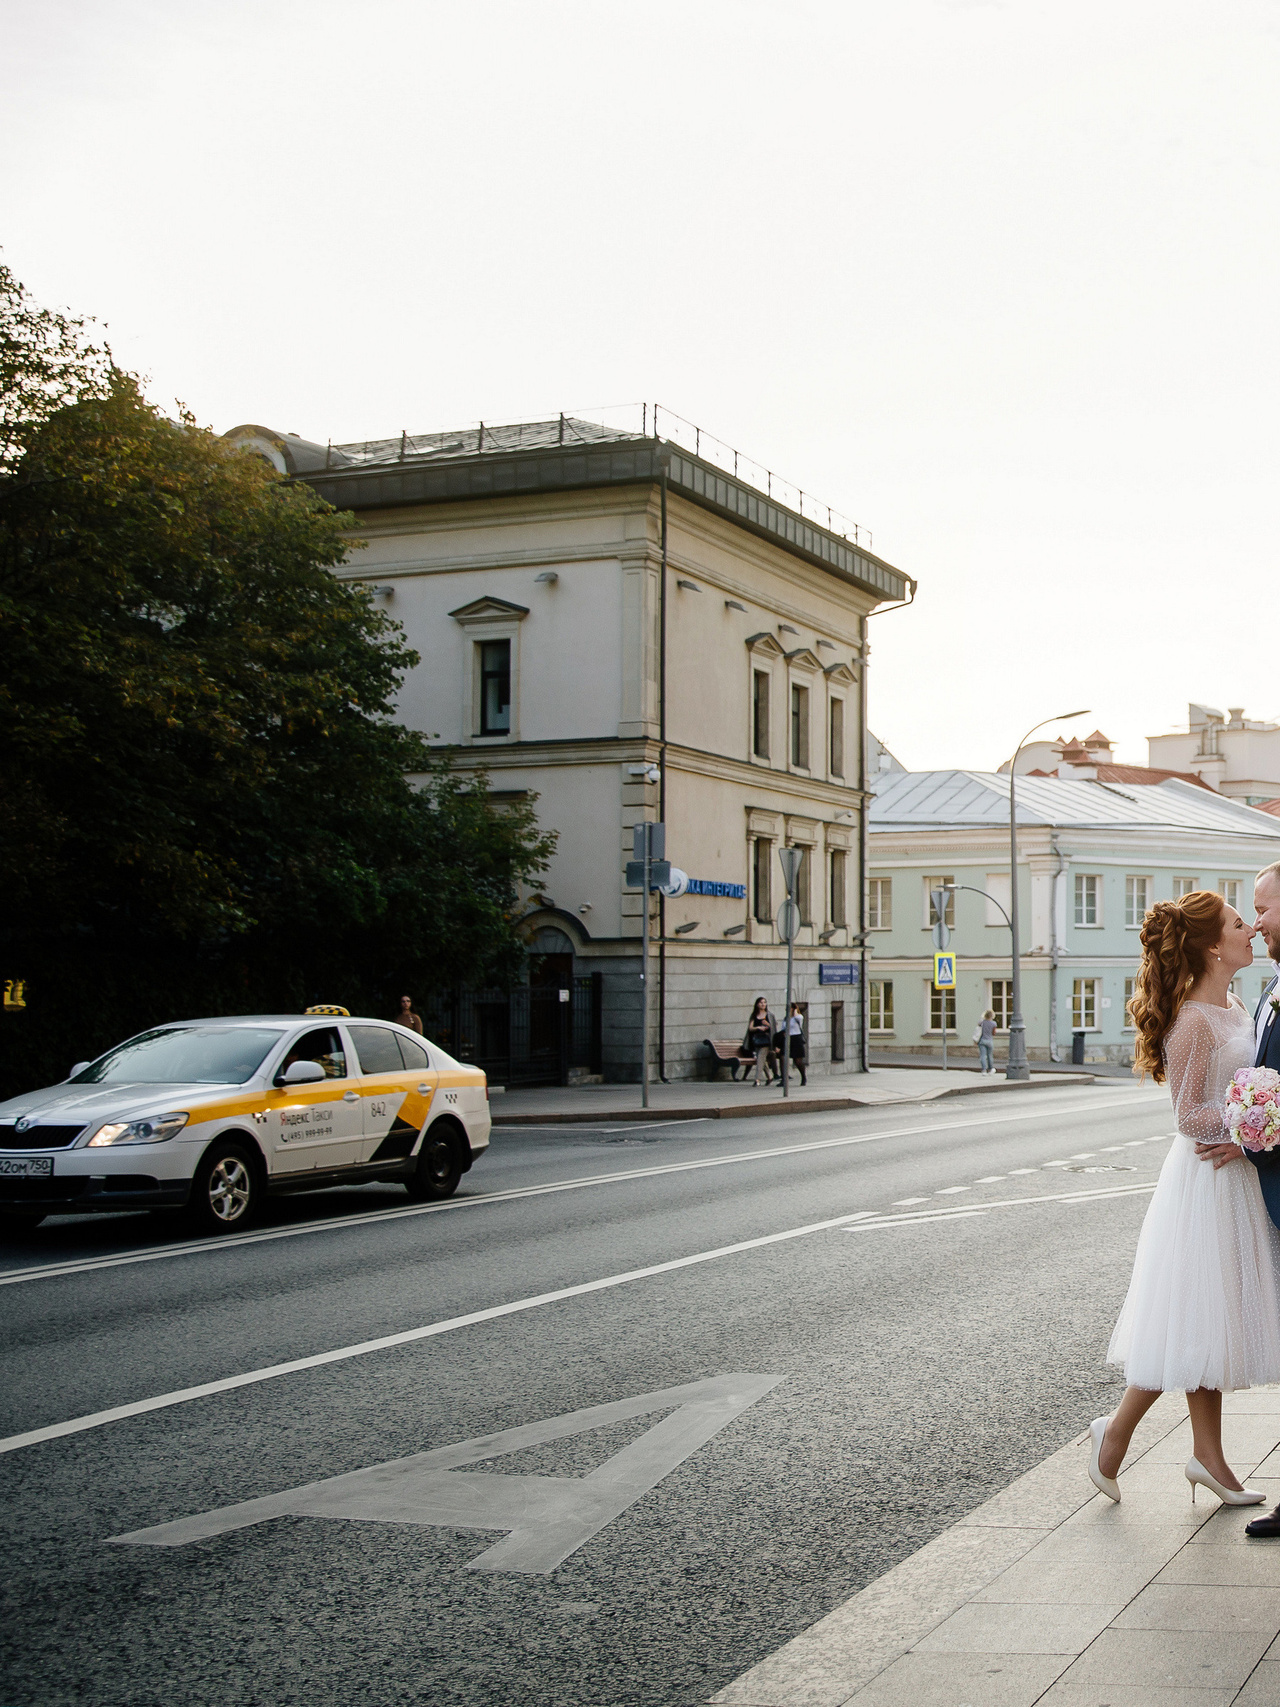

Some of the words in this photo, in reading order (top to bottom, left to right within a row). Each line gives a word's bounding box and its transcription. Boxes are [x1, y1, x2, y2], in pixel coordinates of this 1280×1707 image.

[280, 1112, 310, 1126] Яндекс
[311, 1108, 333, 1122] Такси
[371, 1102, 386, 1117] 842
[29, 1160, 49, 1170] 750
